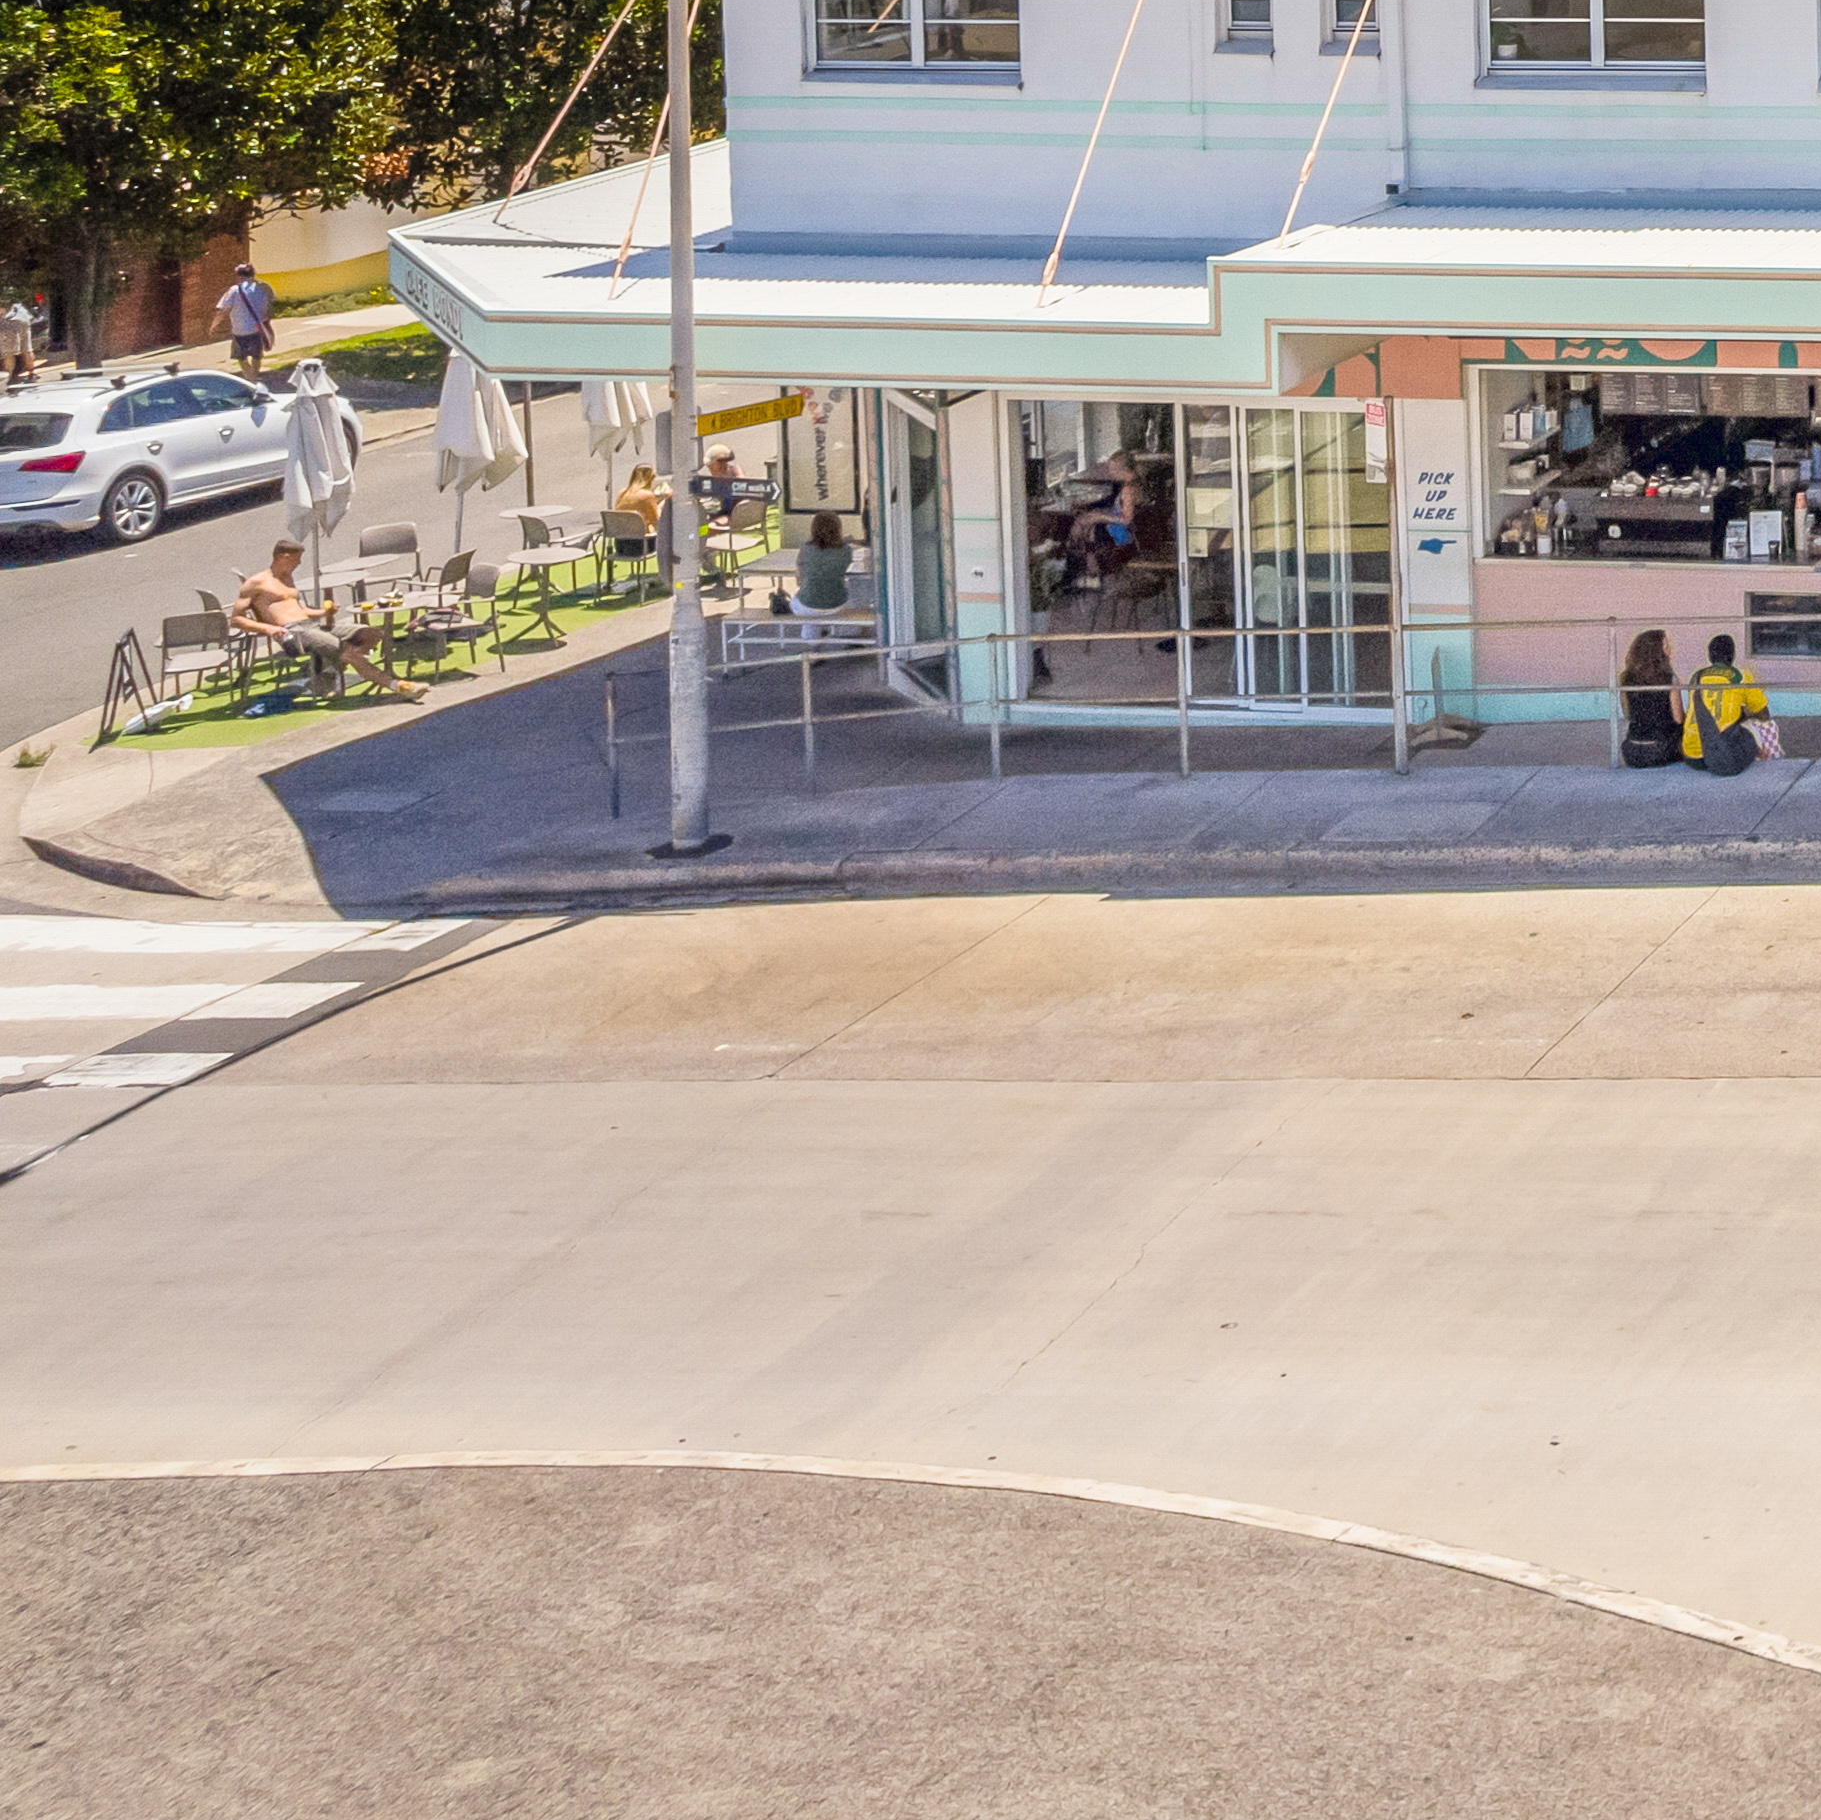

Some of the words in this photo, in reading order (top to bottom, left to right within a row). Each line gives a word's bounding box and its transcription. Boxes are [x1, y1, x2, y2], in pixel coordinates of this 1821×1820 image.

[719, 406, 768, 429] BRIGHTON
[773, 399, 797, 420] BLVD
[814, 427, 829, 501] wherever
[1418, 472, 1455, 485] PICK
[1425, 490, 1448, 502] UP
[1412, 507, 1457, 520] HERE
